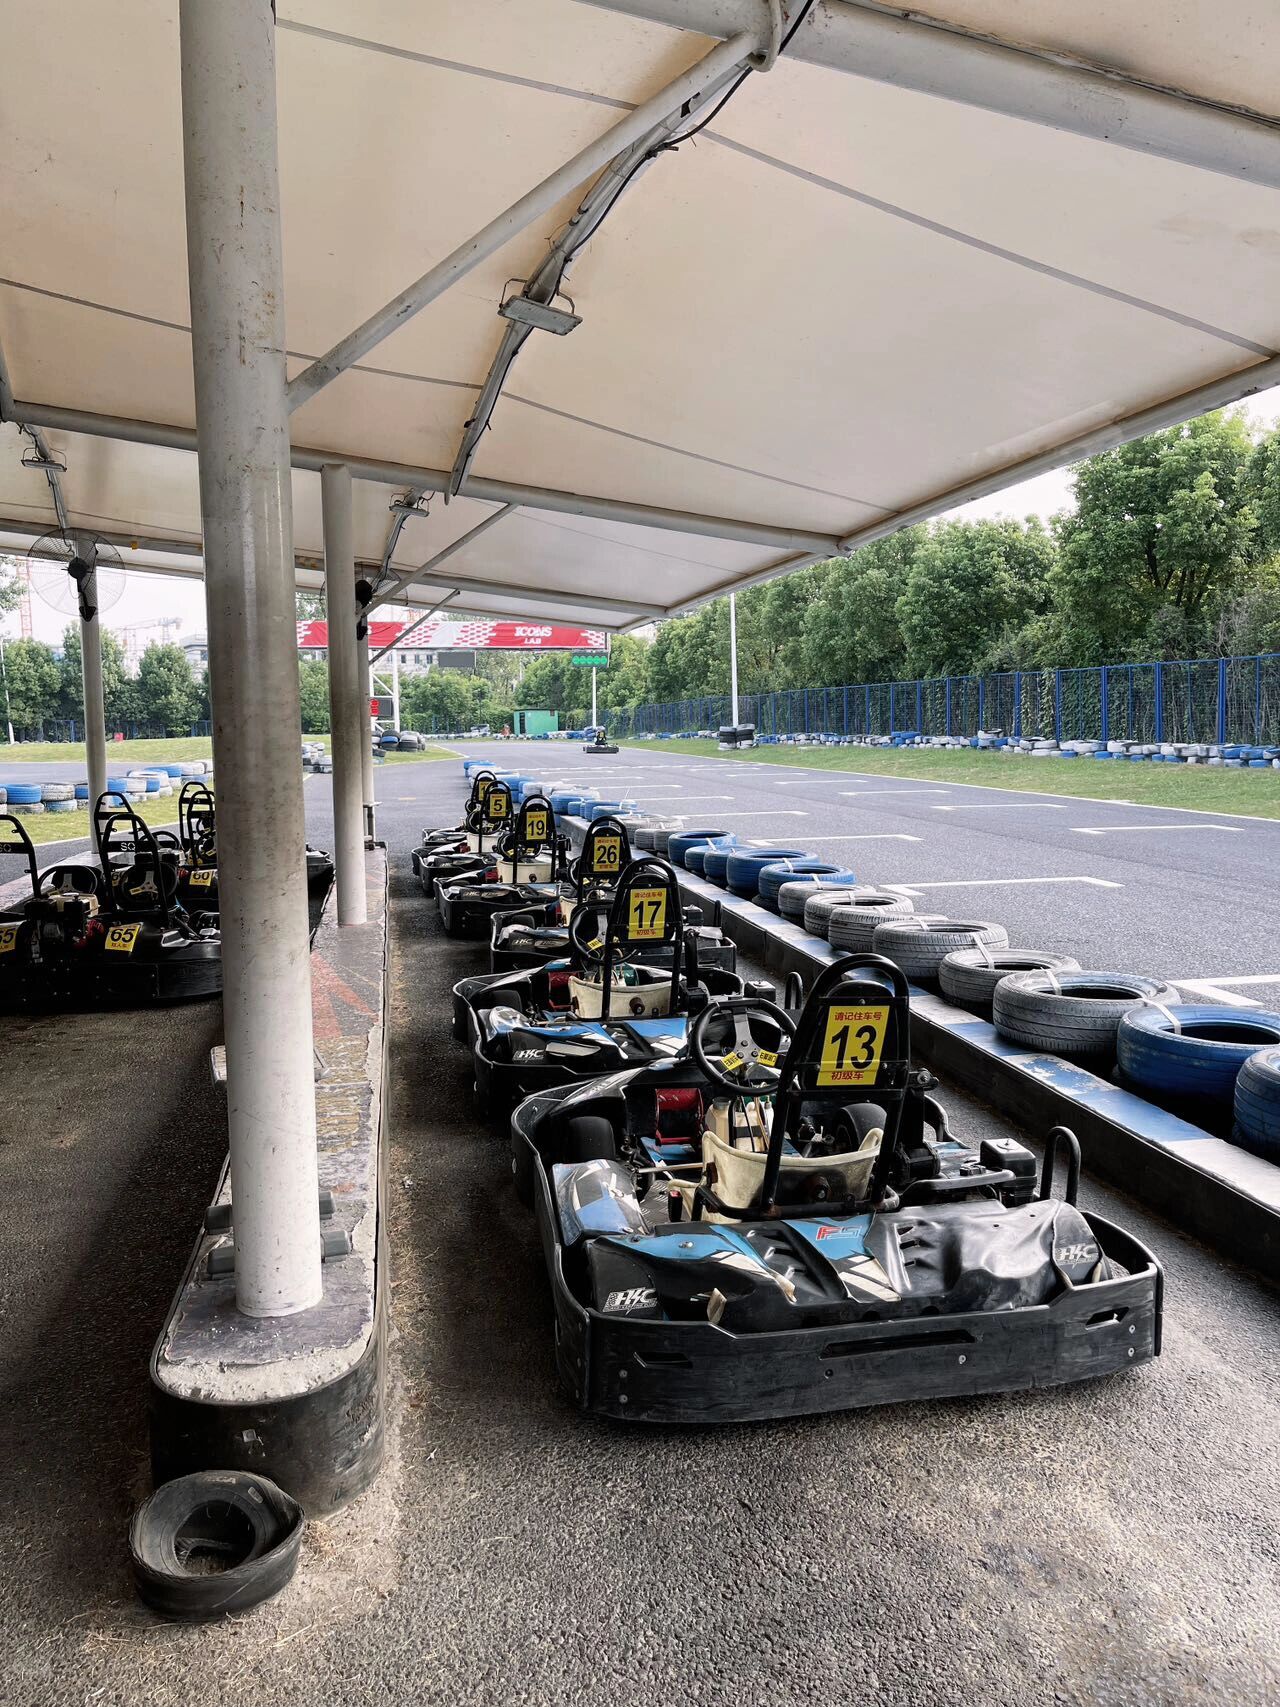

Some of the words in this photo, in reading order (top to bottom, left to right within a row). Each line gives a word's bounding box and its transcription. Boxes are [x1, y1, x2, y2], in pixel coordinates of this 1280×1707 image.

[514, 626, 552, 637] ICONS
[493, 799, 502, 812] 5
[528, 820, 545, 837] 19
[596, 845, 617, 864] 26
[192, 871, 210, 881] 60
[633, 900, 662, 929] 17
[0, 928, 16, 944] 5
[110, 928, 136, 943] 65
[834, 1011, 882, 1021] 请记住车号
[830, 1024, 877, 1070] 13
[831, 1071, 864, 1081] 初级车
